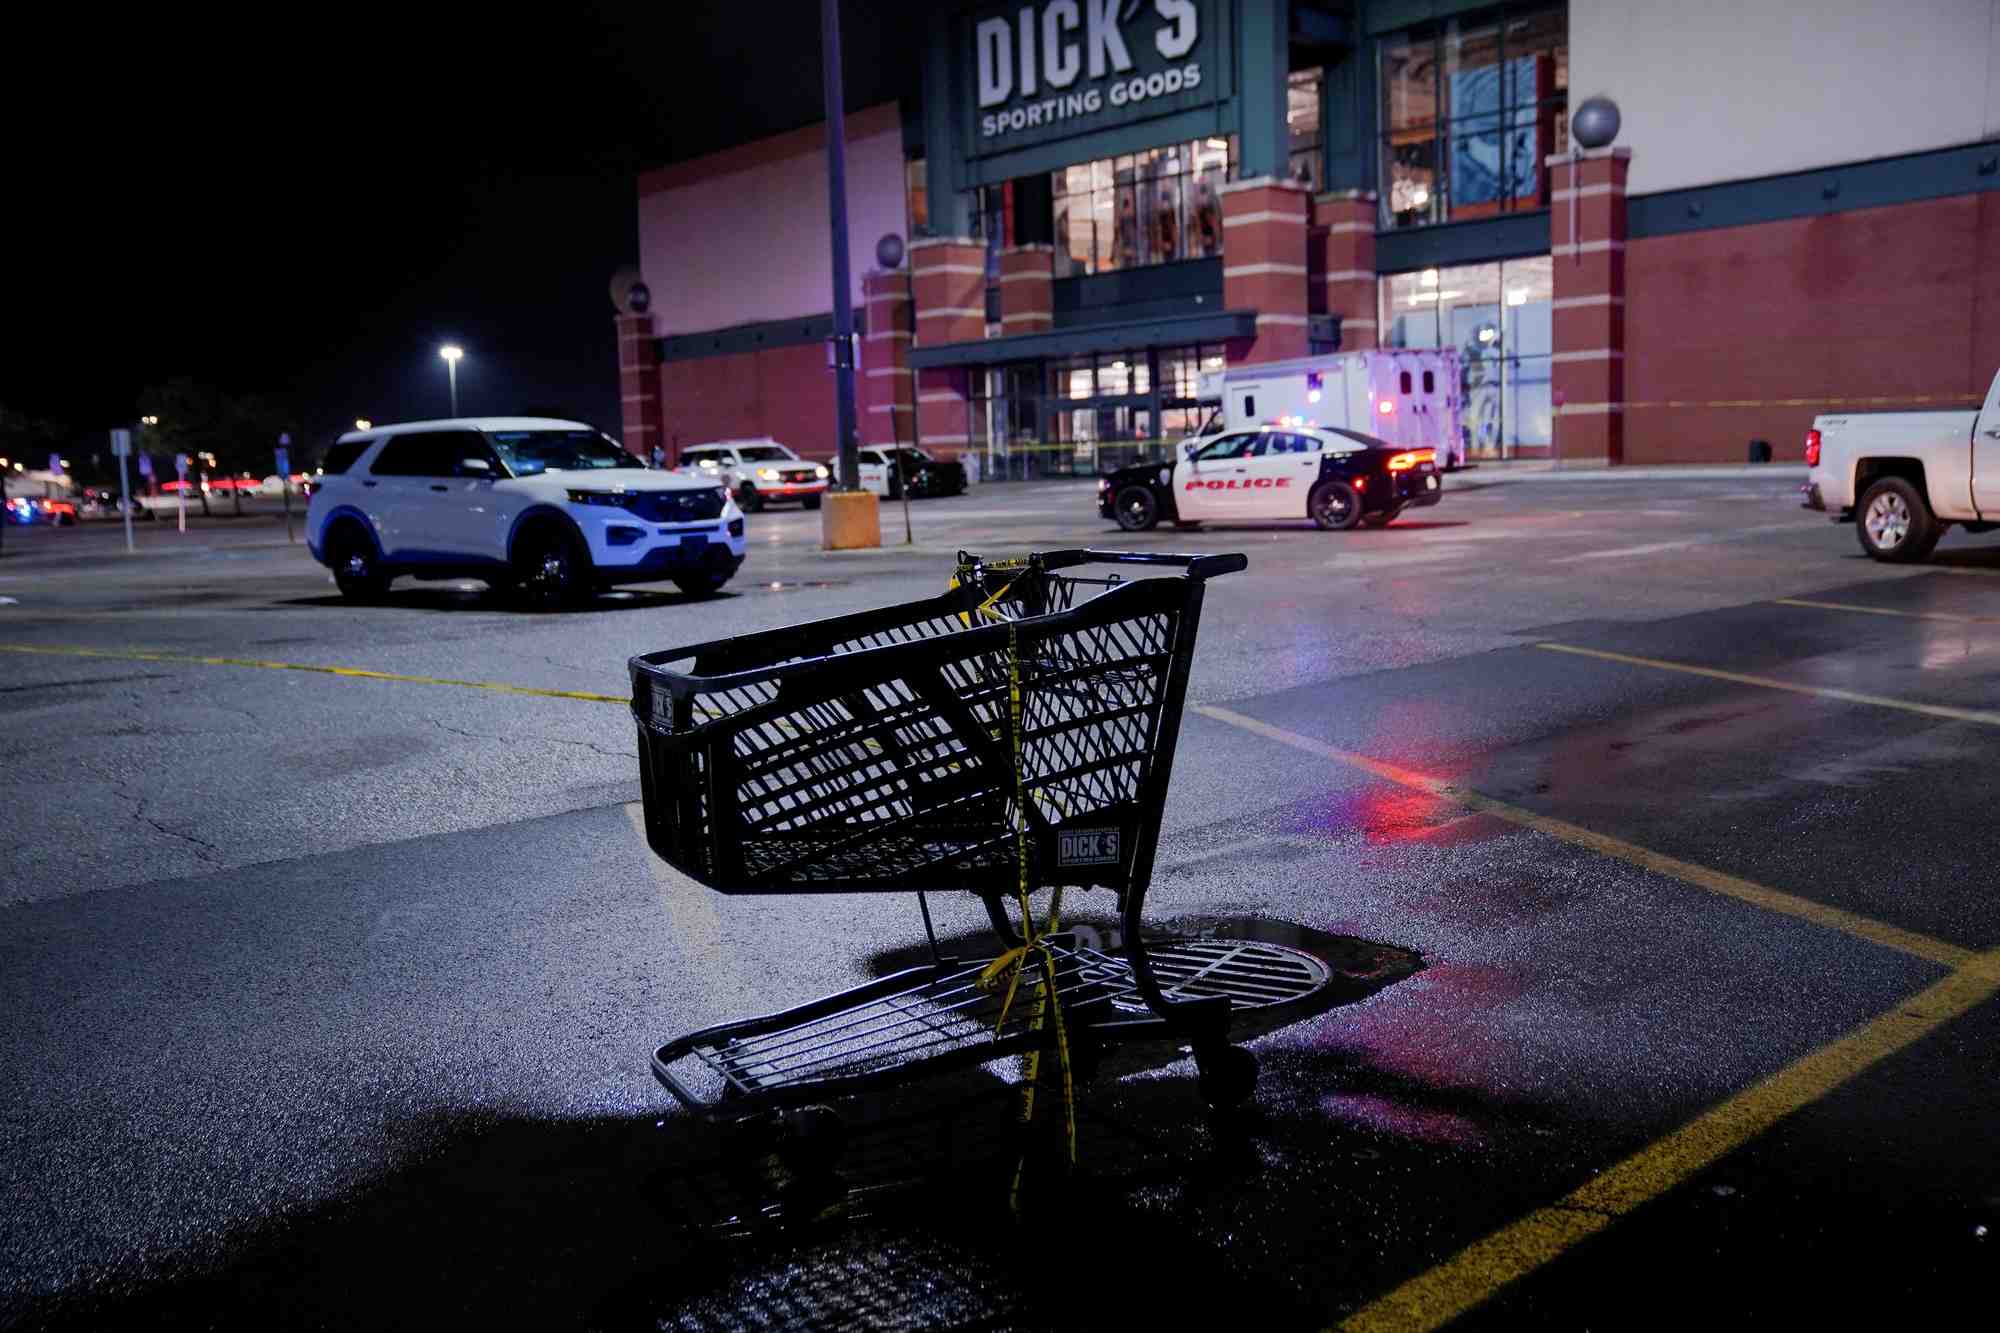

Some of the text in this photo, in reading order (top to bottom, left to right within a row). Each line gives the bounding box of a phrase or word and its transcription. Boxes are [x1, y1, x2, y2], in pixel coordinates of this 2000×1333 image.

[983, 64, 1201, 137] SPORTING GOODS
[1185, 477, 1293, 491] POLICE
